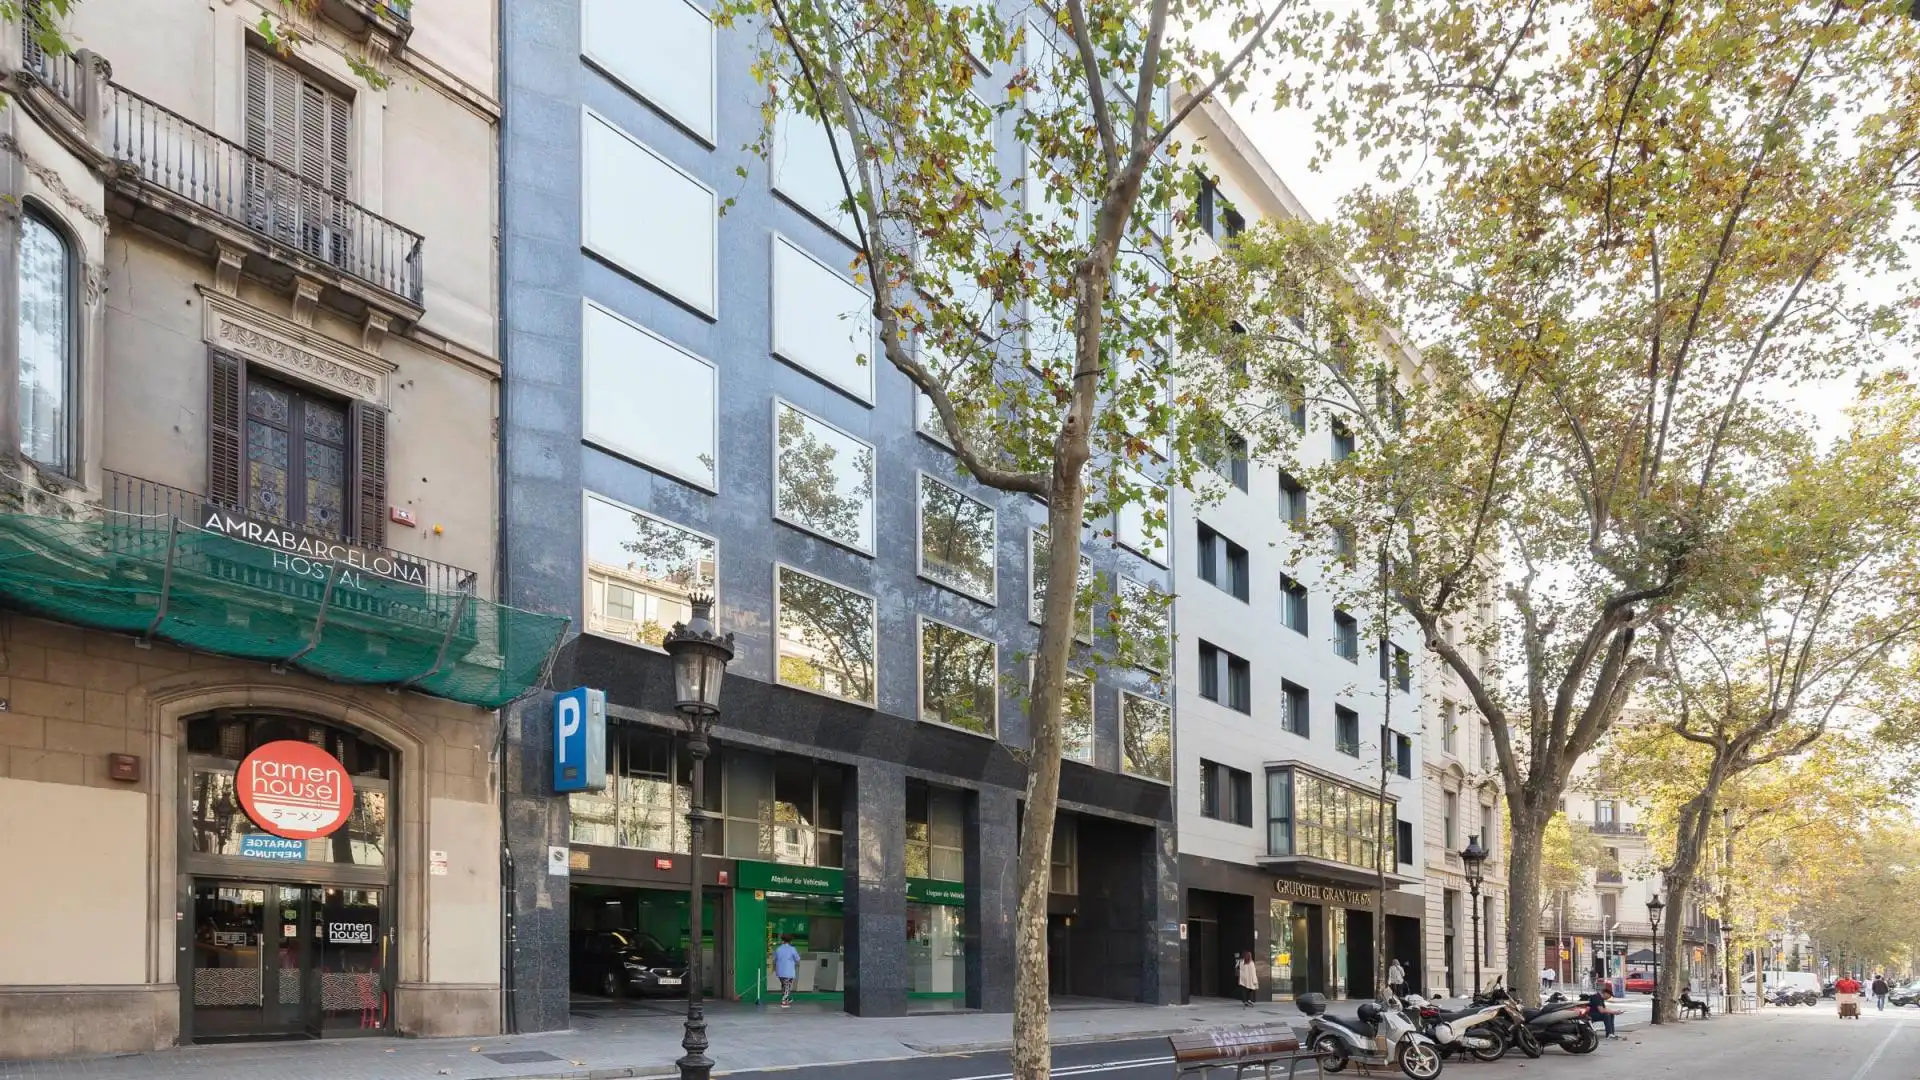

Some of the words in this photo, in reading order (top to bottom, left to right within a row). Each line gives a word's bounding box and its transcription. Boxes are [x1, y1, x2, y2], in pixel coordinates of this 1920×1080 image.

[205, 513, 424, 584] AMRABARCELONA
[559, 697, 580, 763] P
[252, 760, 340, 785] ramen
[252, 777, 332, 799] house
[272, 808, 322, 821] ラーメン
[1277, 880, 1320, 899] GRUPOTEL
[1322, 888, 1345, 902] GRAN
[330, 922, 372, 931] ramen
[330, 930, 369, 940] house
